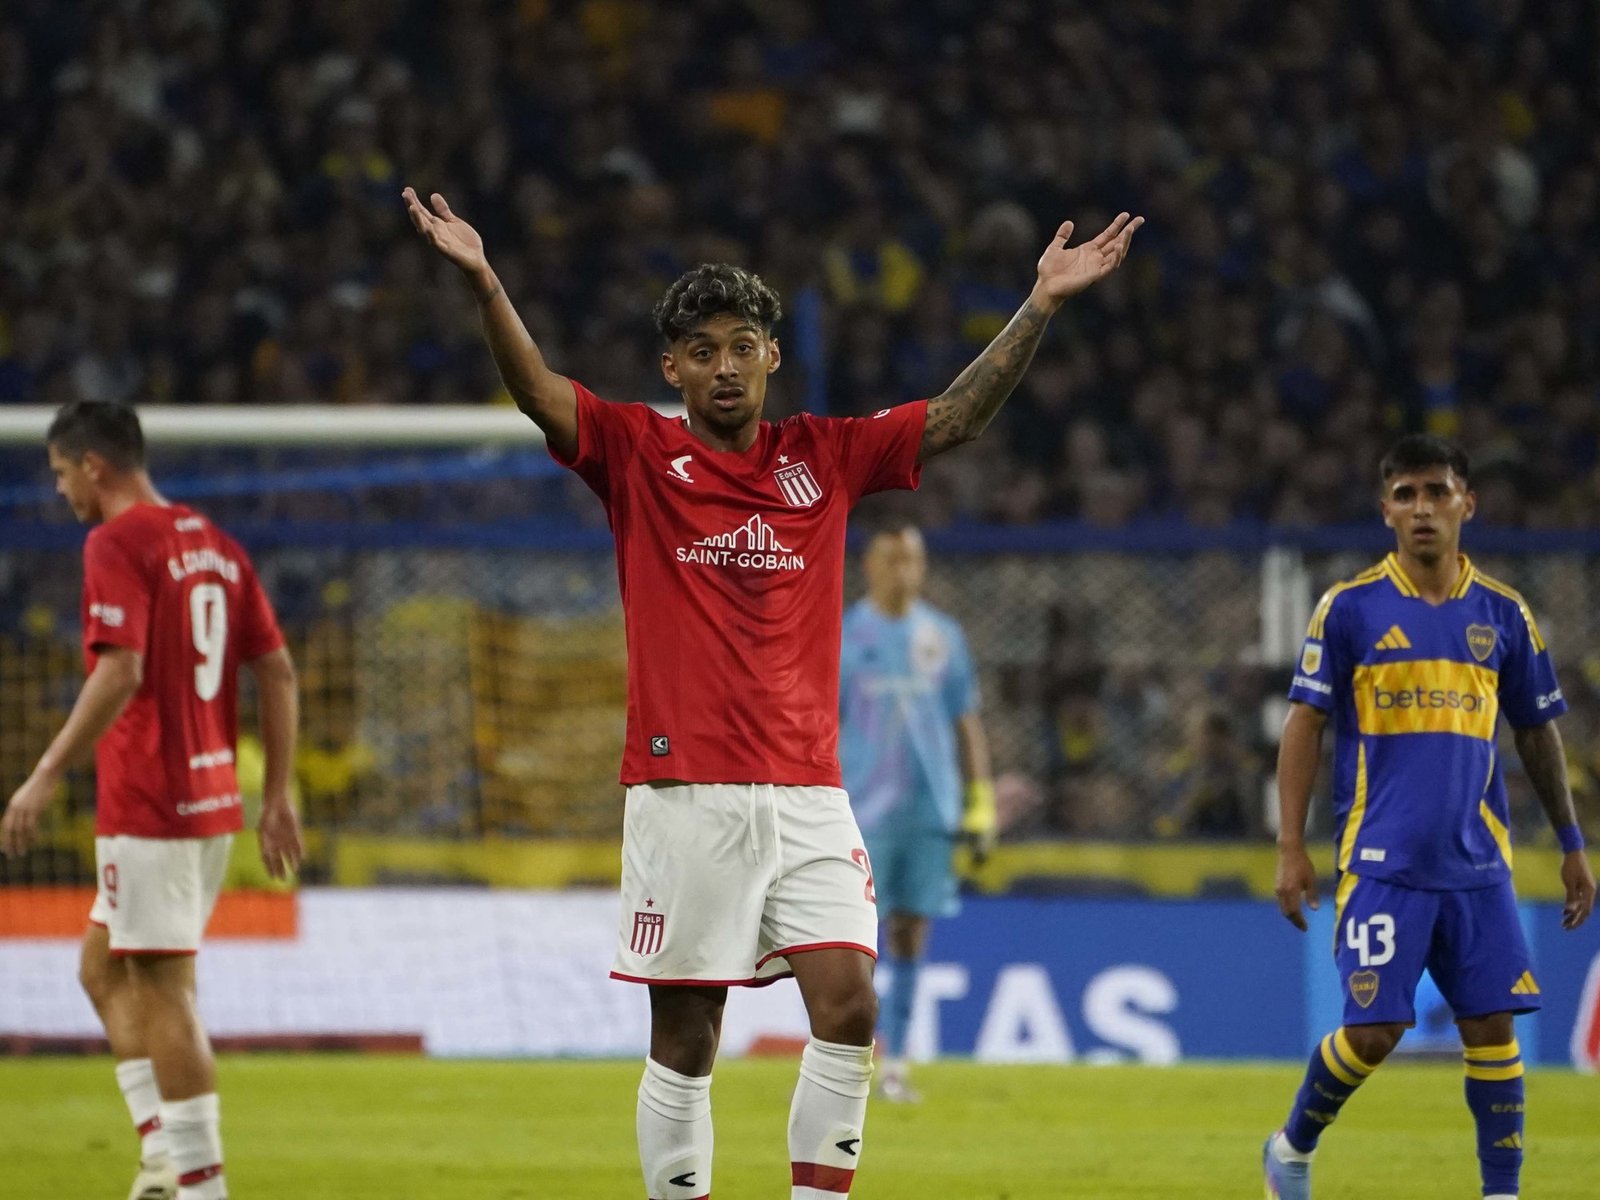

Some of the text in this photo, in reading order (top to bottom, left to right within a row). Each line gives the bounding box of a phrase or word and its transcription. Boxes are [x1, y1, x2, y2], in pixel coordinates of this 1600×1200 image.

[676, 547, 805, 571] SAINT-GOBAIN
[189, 582, 227, 702] 9
[1346, 913, 1397, 967] 43
